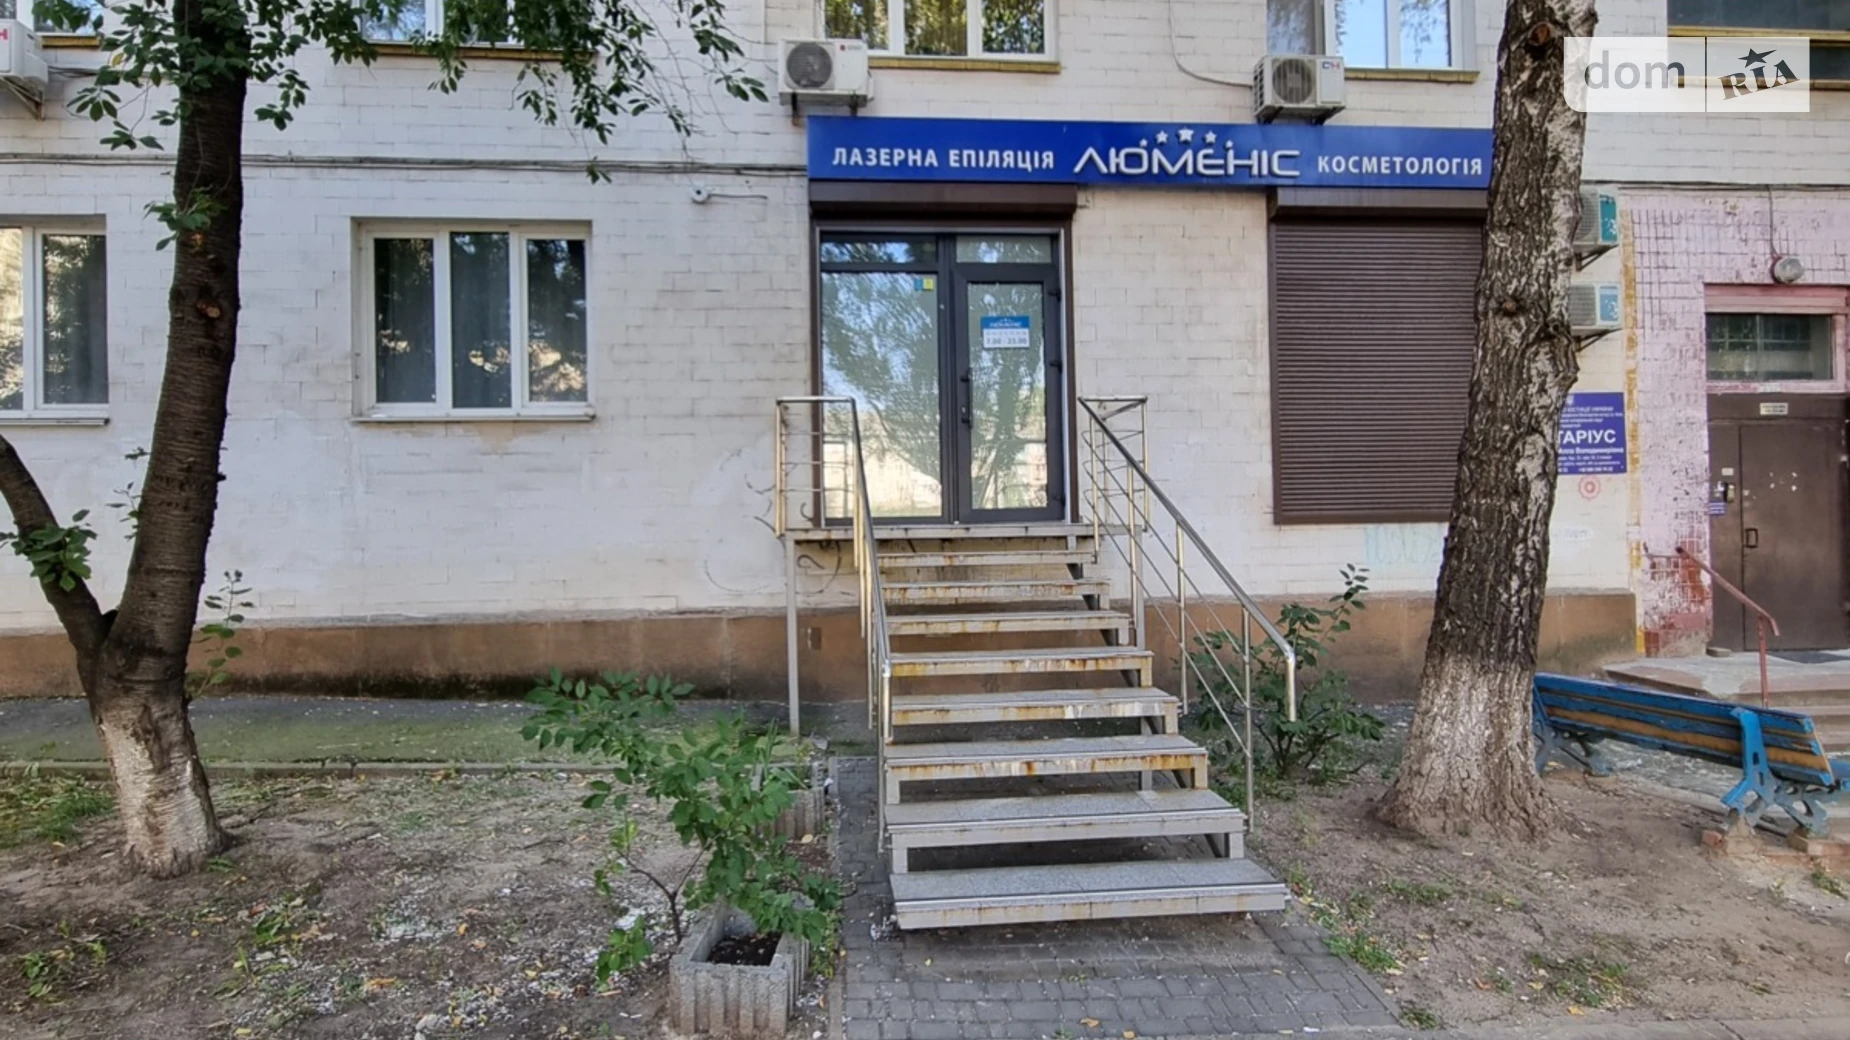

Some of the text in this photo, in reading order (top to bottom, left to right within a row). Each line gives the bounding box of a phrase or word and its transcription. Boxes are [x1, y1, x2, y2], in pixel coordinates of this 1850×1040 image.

[832, 147, 1054, 173] ЛАЗЕРНА ЕПІЛЯЦІЯ
[1317, 155, 1482, 177] КОСМЕТОЛОГІЯ
